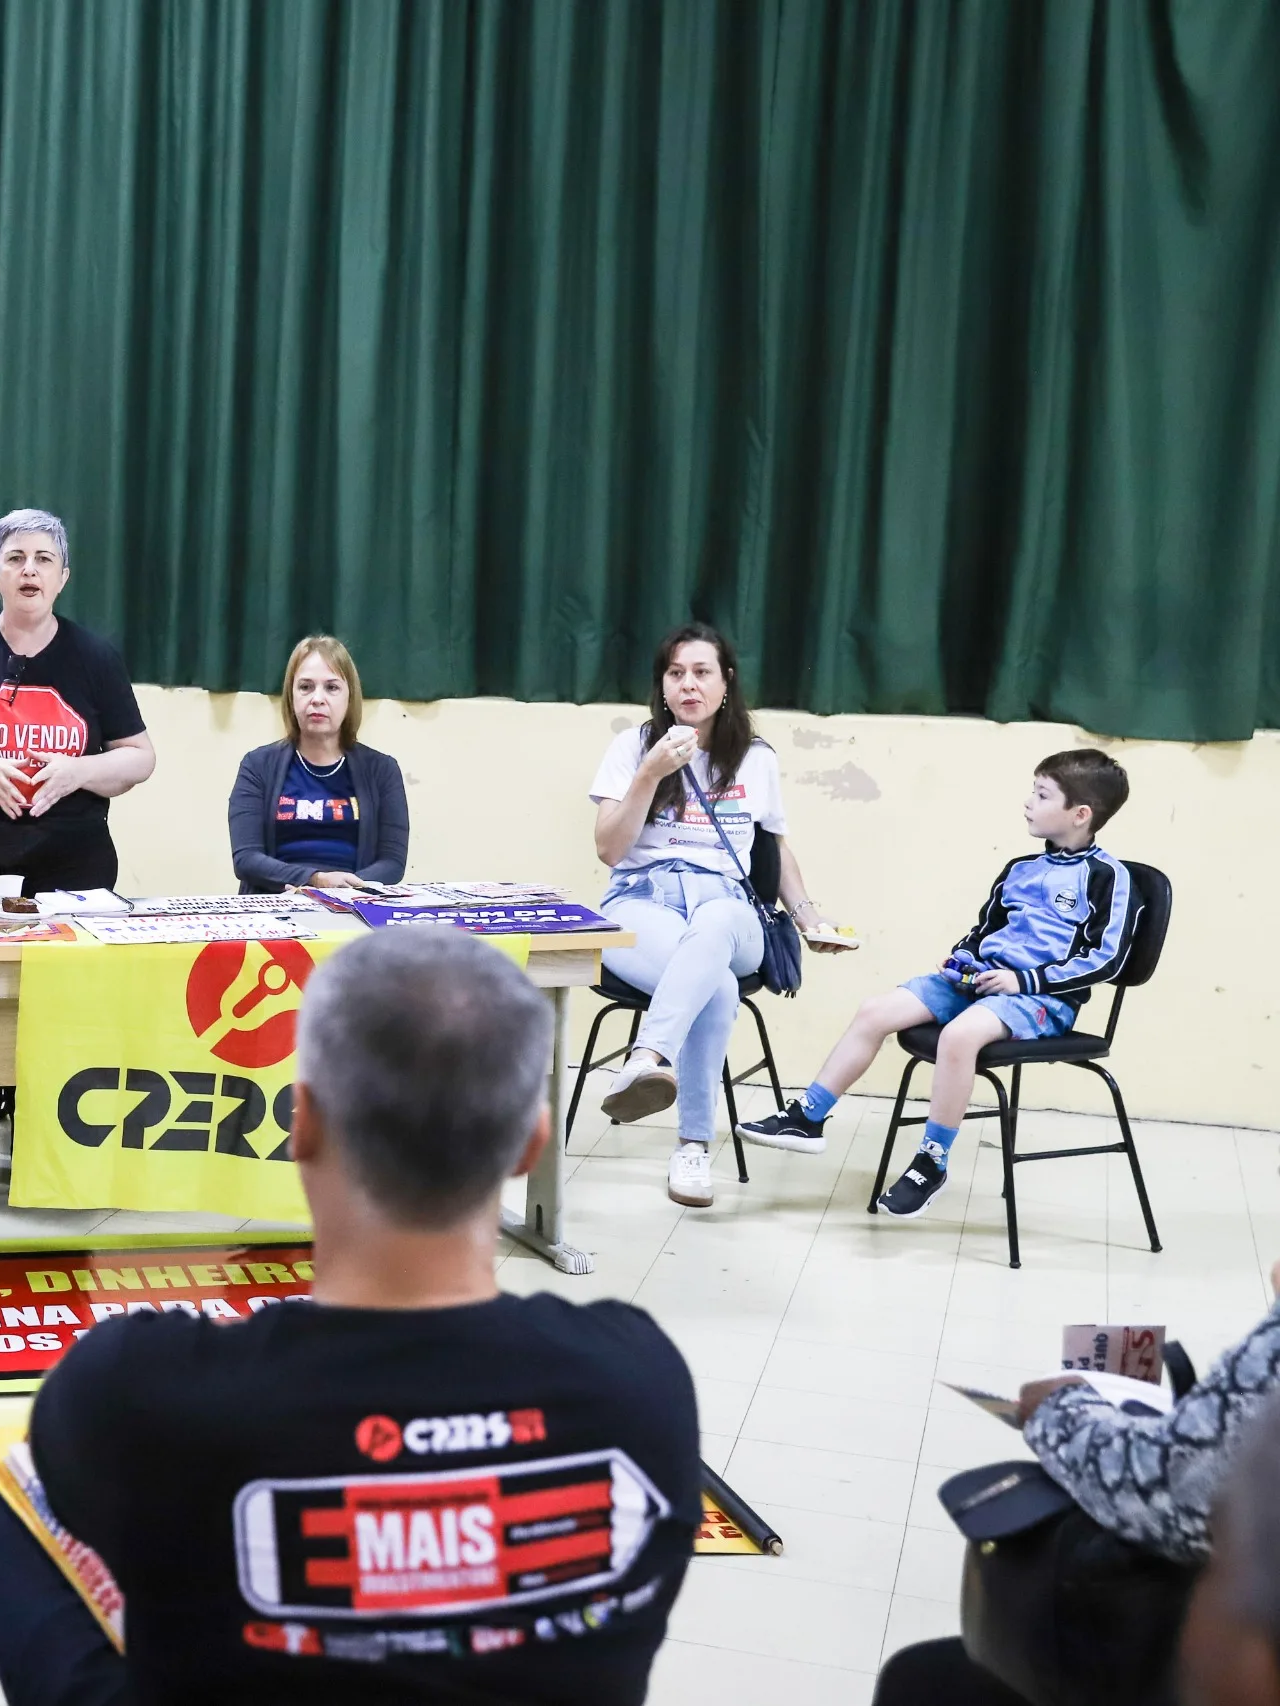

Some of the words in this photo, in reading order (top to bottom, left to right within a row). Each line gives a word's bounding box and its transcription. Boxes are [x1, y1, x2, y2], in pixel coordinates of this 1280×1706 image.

[15, 724, 80, 750] VENDA
[392, 910, 506, 919] PAREM
[513, 909, 557, 918] DE
[463, 915, 584, 925] MATAR
[354, 1503, 497, 1573] MAIS
